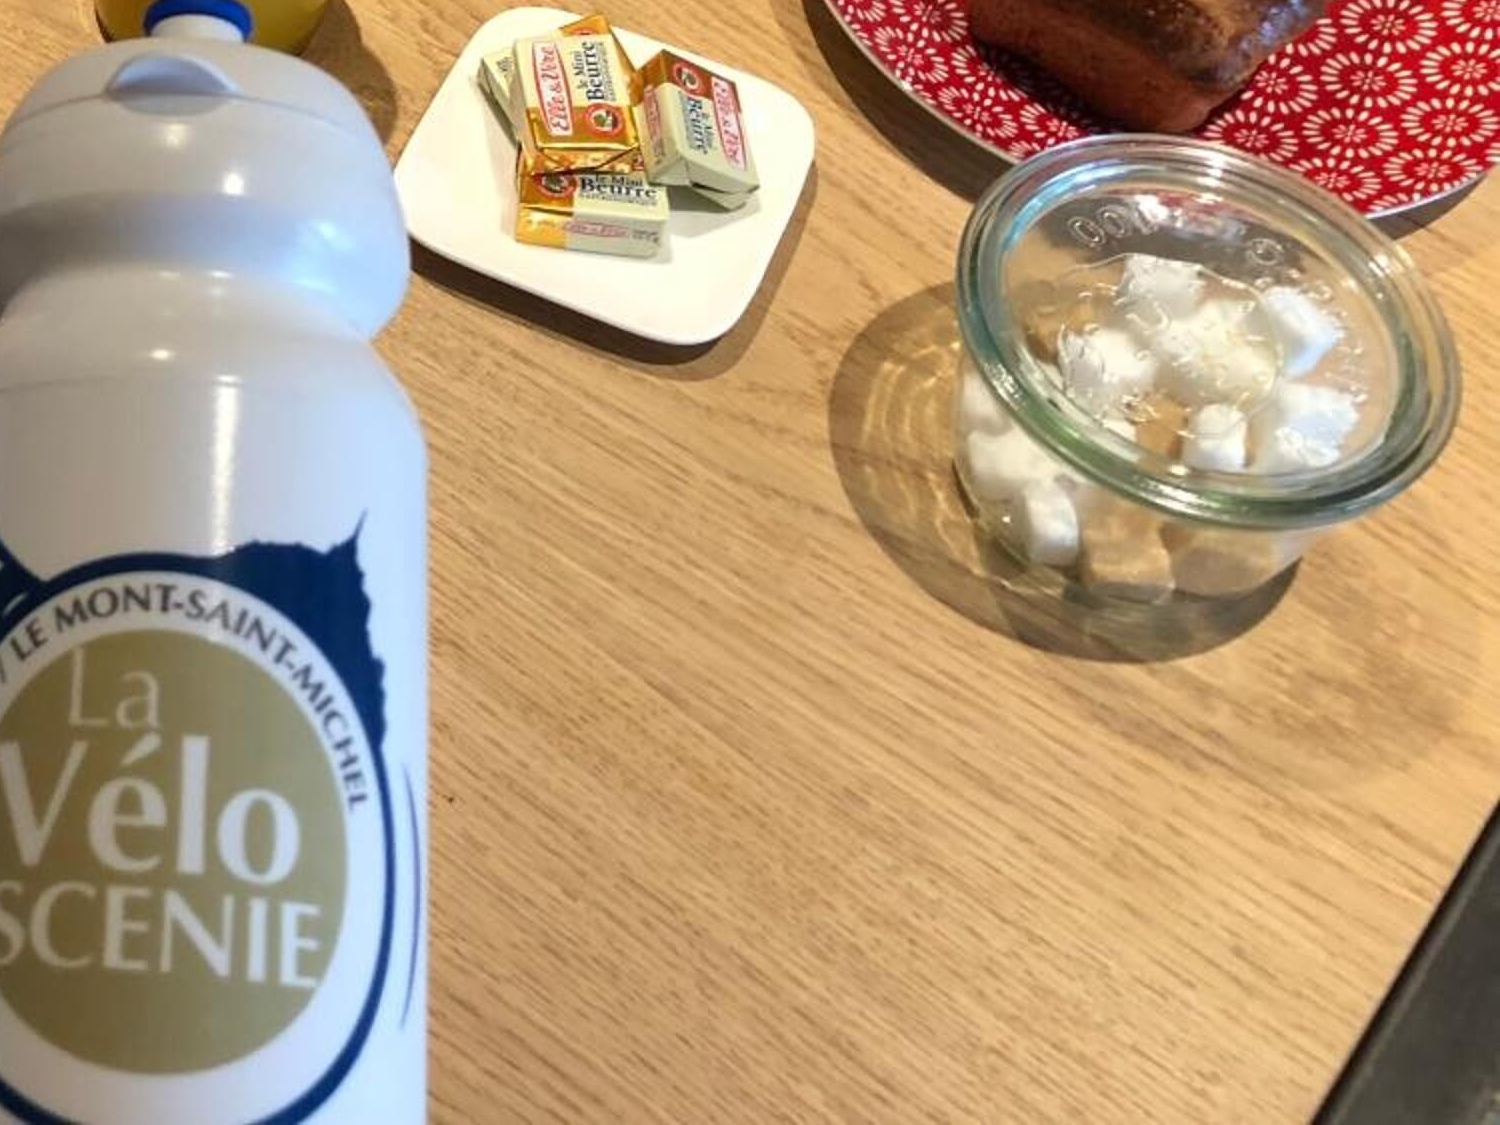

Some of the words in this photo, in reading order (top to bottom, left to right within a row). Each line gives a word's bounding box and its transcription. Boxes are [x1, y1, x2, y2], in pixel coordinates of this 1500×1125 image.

[581, 41, 605, 101] Beurre
[687, 97, 708, 155] Beurre
[579, 177, 658, 198] Beurre
[10, 621, 50, 662] LE
[55, 583, 369, 811] MONT-SAINT-MICHEL
[69, 649, 161, 729] La
